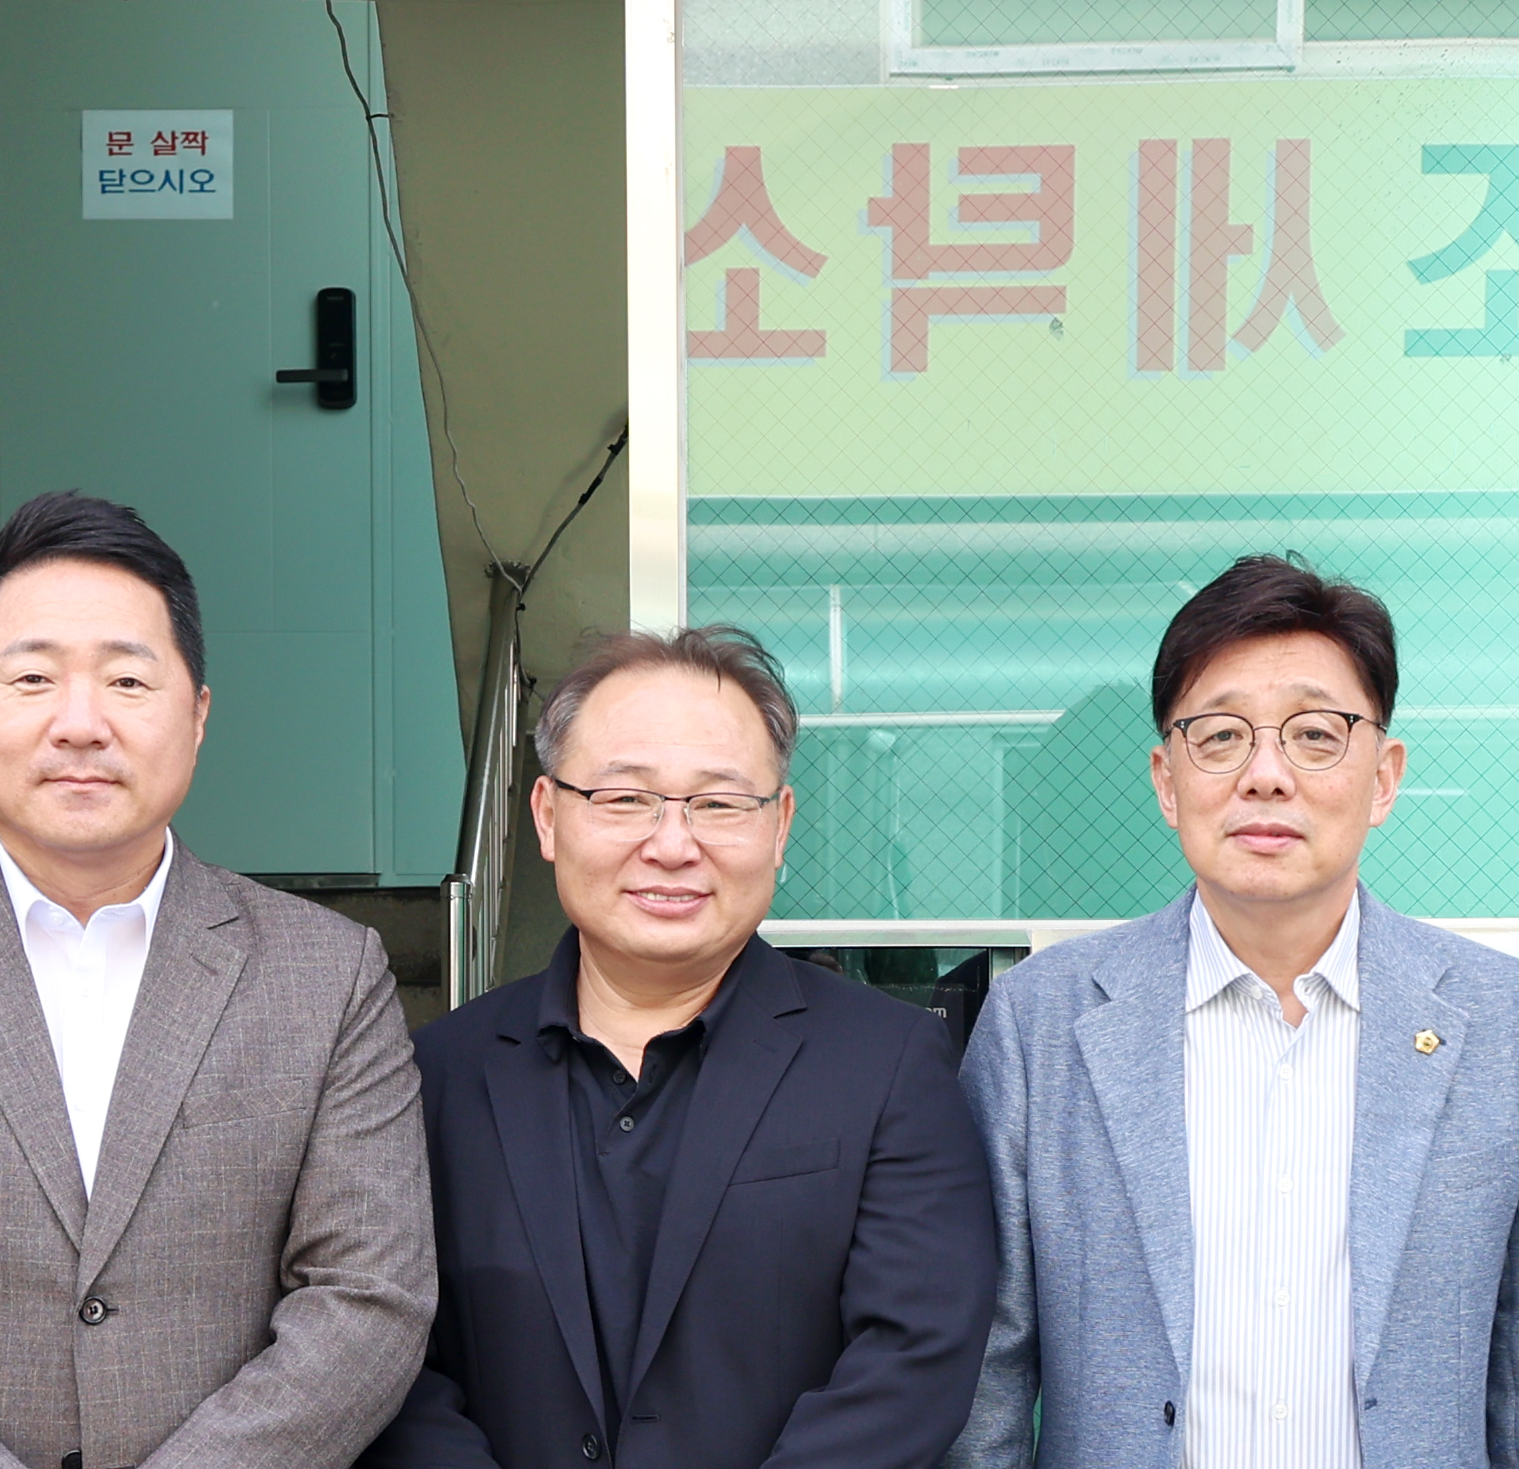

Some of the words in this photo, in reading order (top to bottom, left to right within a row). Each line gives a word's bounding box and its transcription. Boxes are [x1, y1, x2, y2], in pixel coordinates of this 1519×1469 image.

[106, 131, 134, 156] 문
[150, 130, 209, 156] 살짝
[98, 168, 216, 194] 닫으시오
